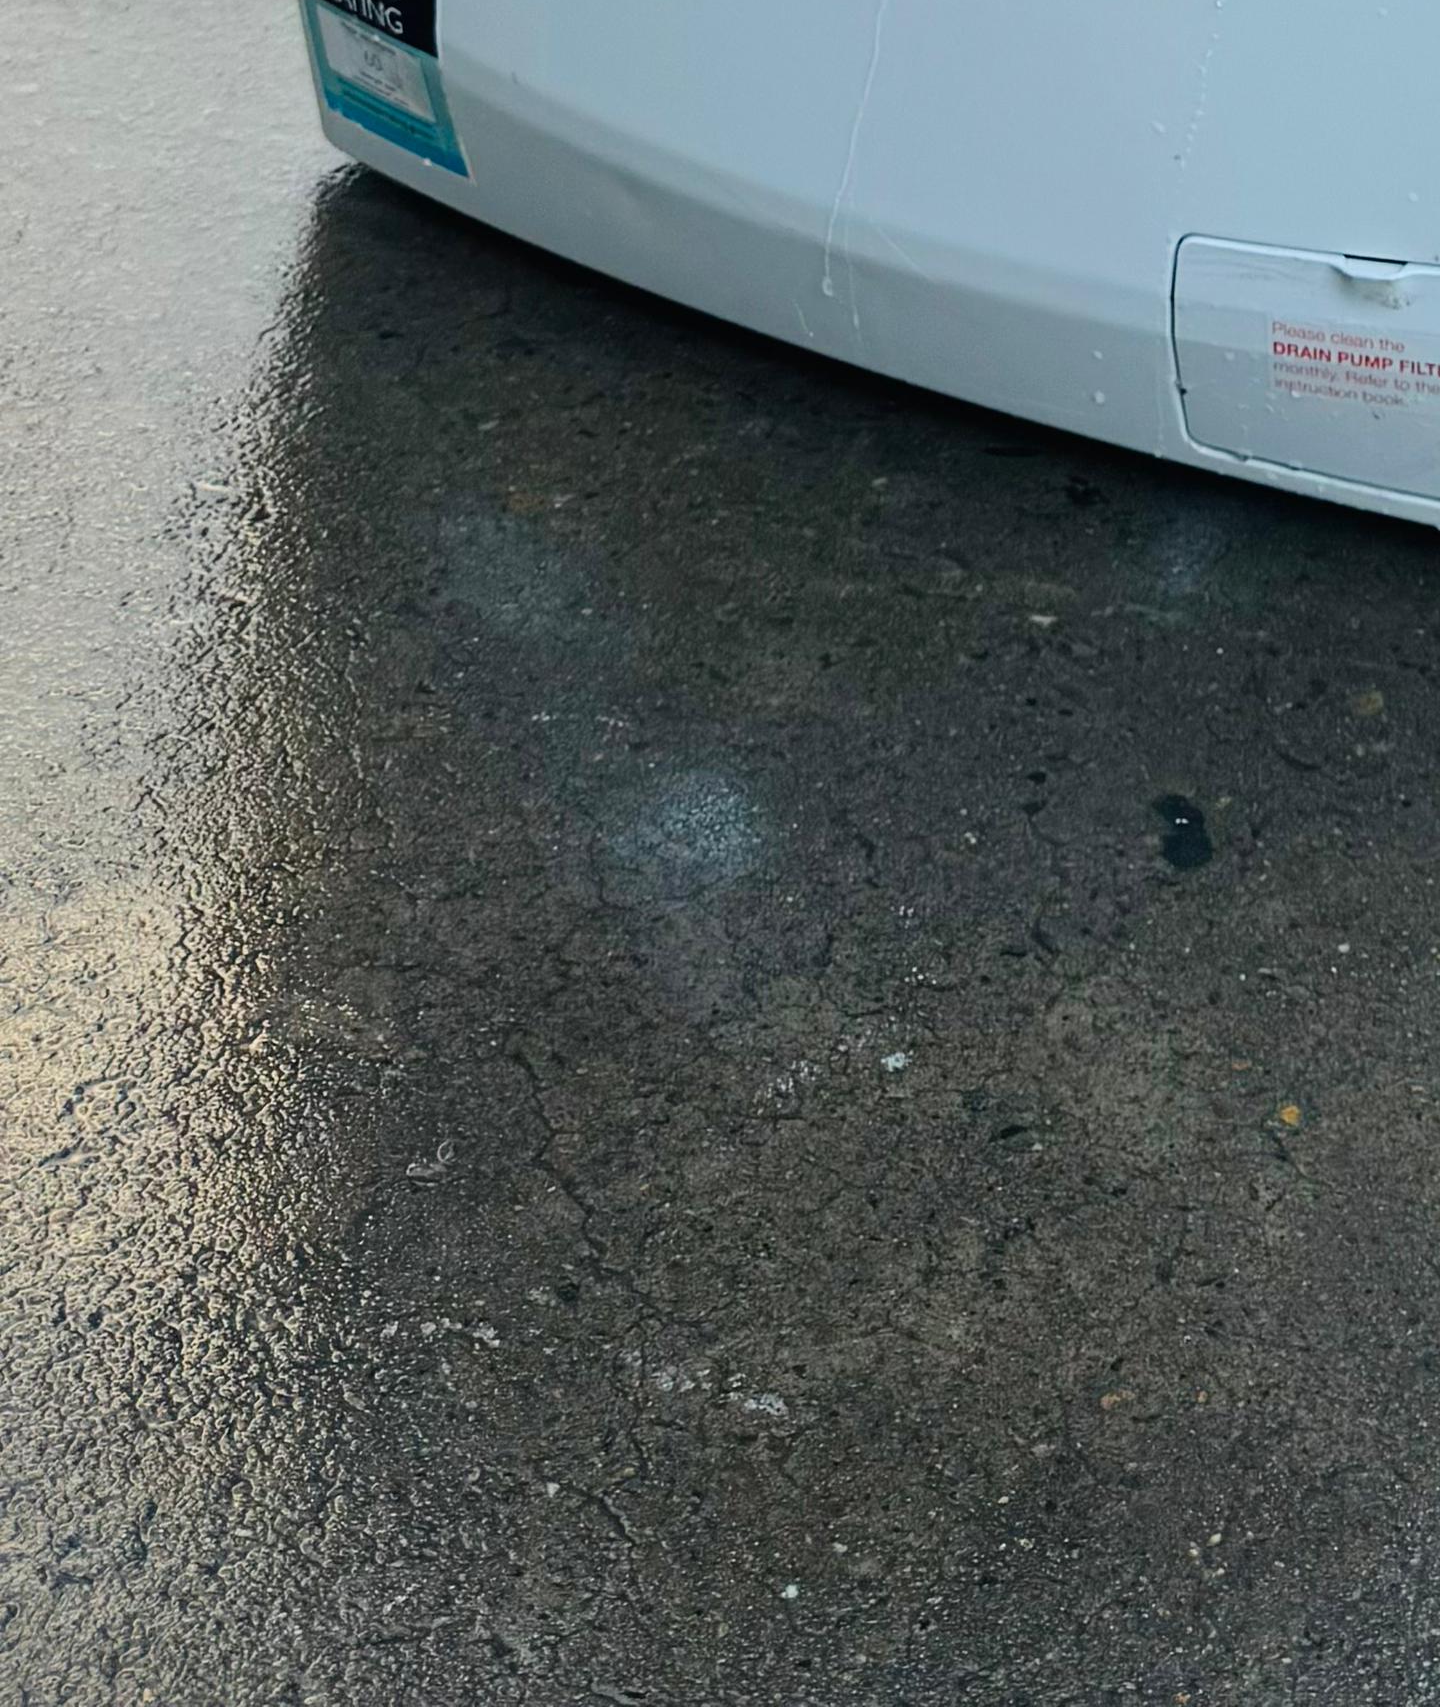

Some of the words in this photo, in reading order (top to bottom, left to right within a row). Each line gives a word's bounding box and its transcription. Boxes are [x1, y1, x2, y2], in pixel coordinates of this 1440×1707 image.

[1272, 321, 1326, 342] Please
[1330, 332, 1374, 349] clean
[1379, 338, 1405, 353] the
[1273, 341, 1331, 363] DRAIN
[1338, 351, 1393, 370] PUMP
[1394, 378, 1410, 392] to
